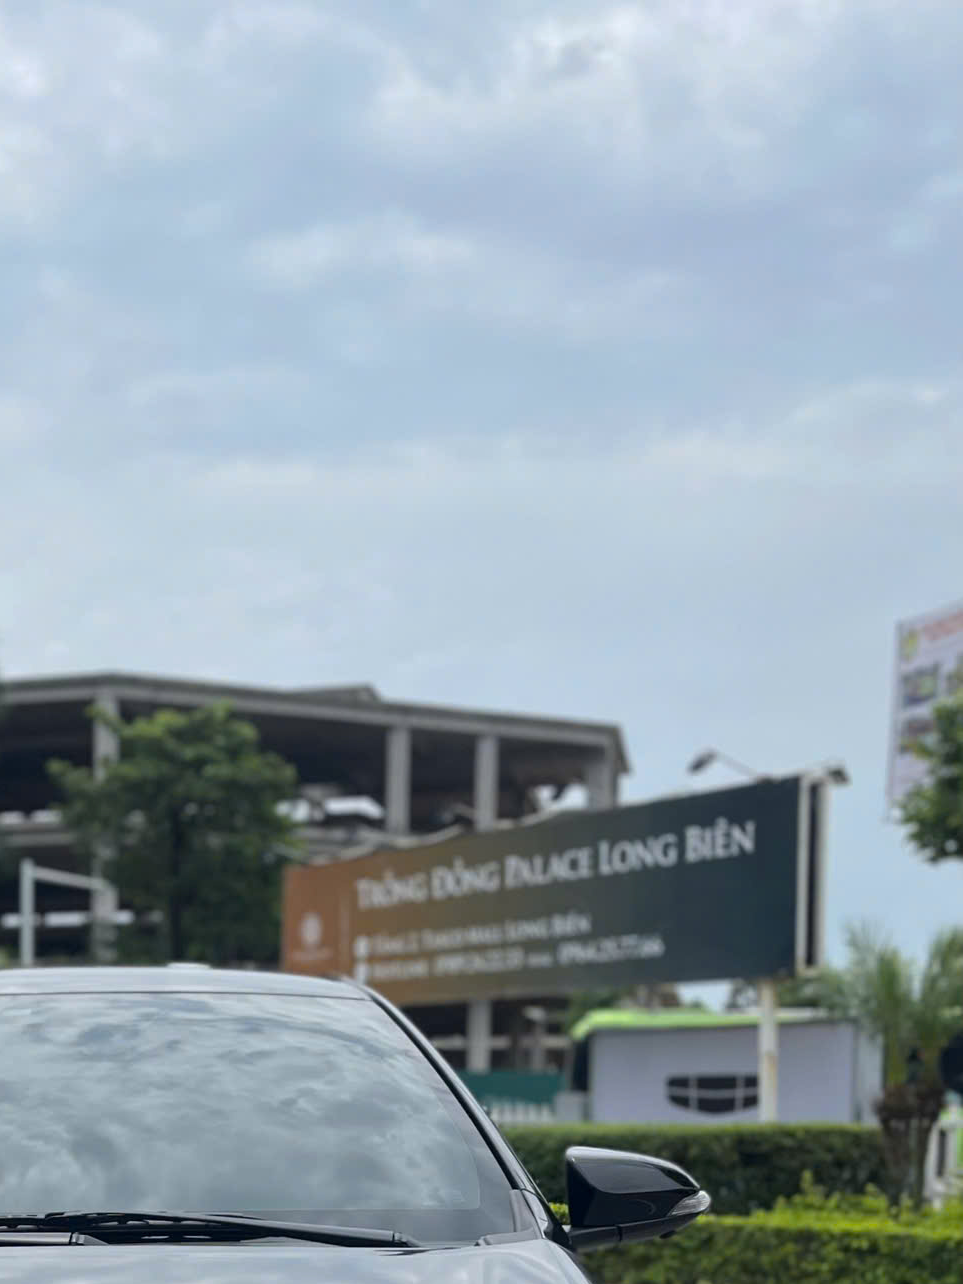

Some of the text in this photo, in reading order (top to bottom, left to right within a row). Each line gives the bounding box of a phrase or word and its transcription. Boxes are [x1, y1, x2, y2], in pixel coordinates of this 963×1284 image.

[503, 847, 592, 888] PALACE
[597, 832, 679, 876] LONG
[684, 816, 756, 864] BIÊN
